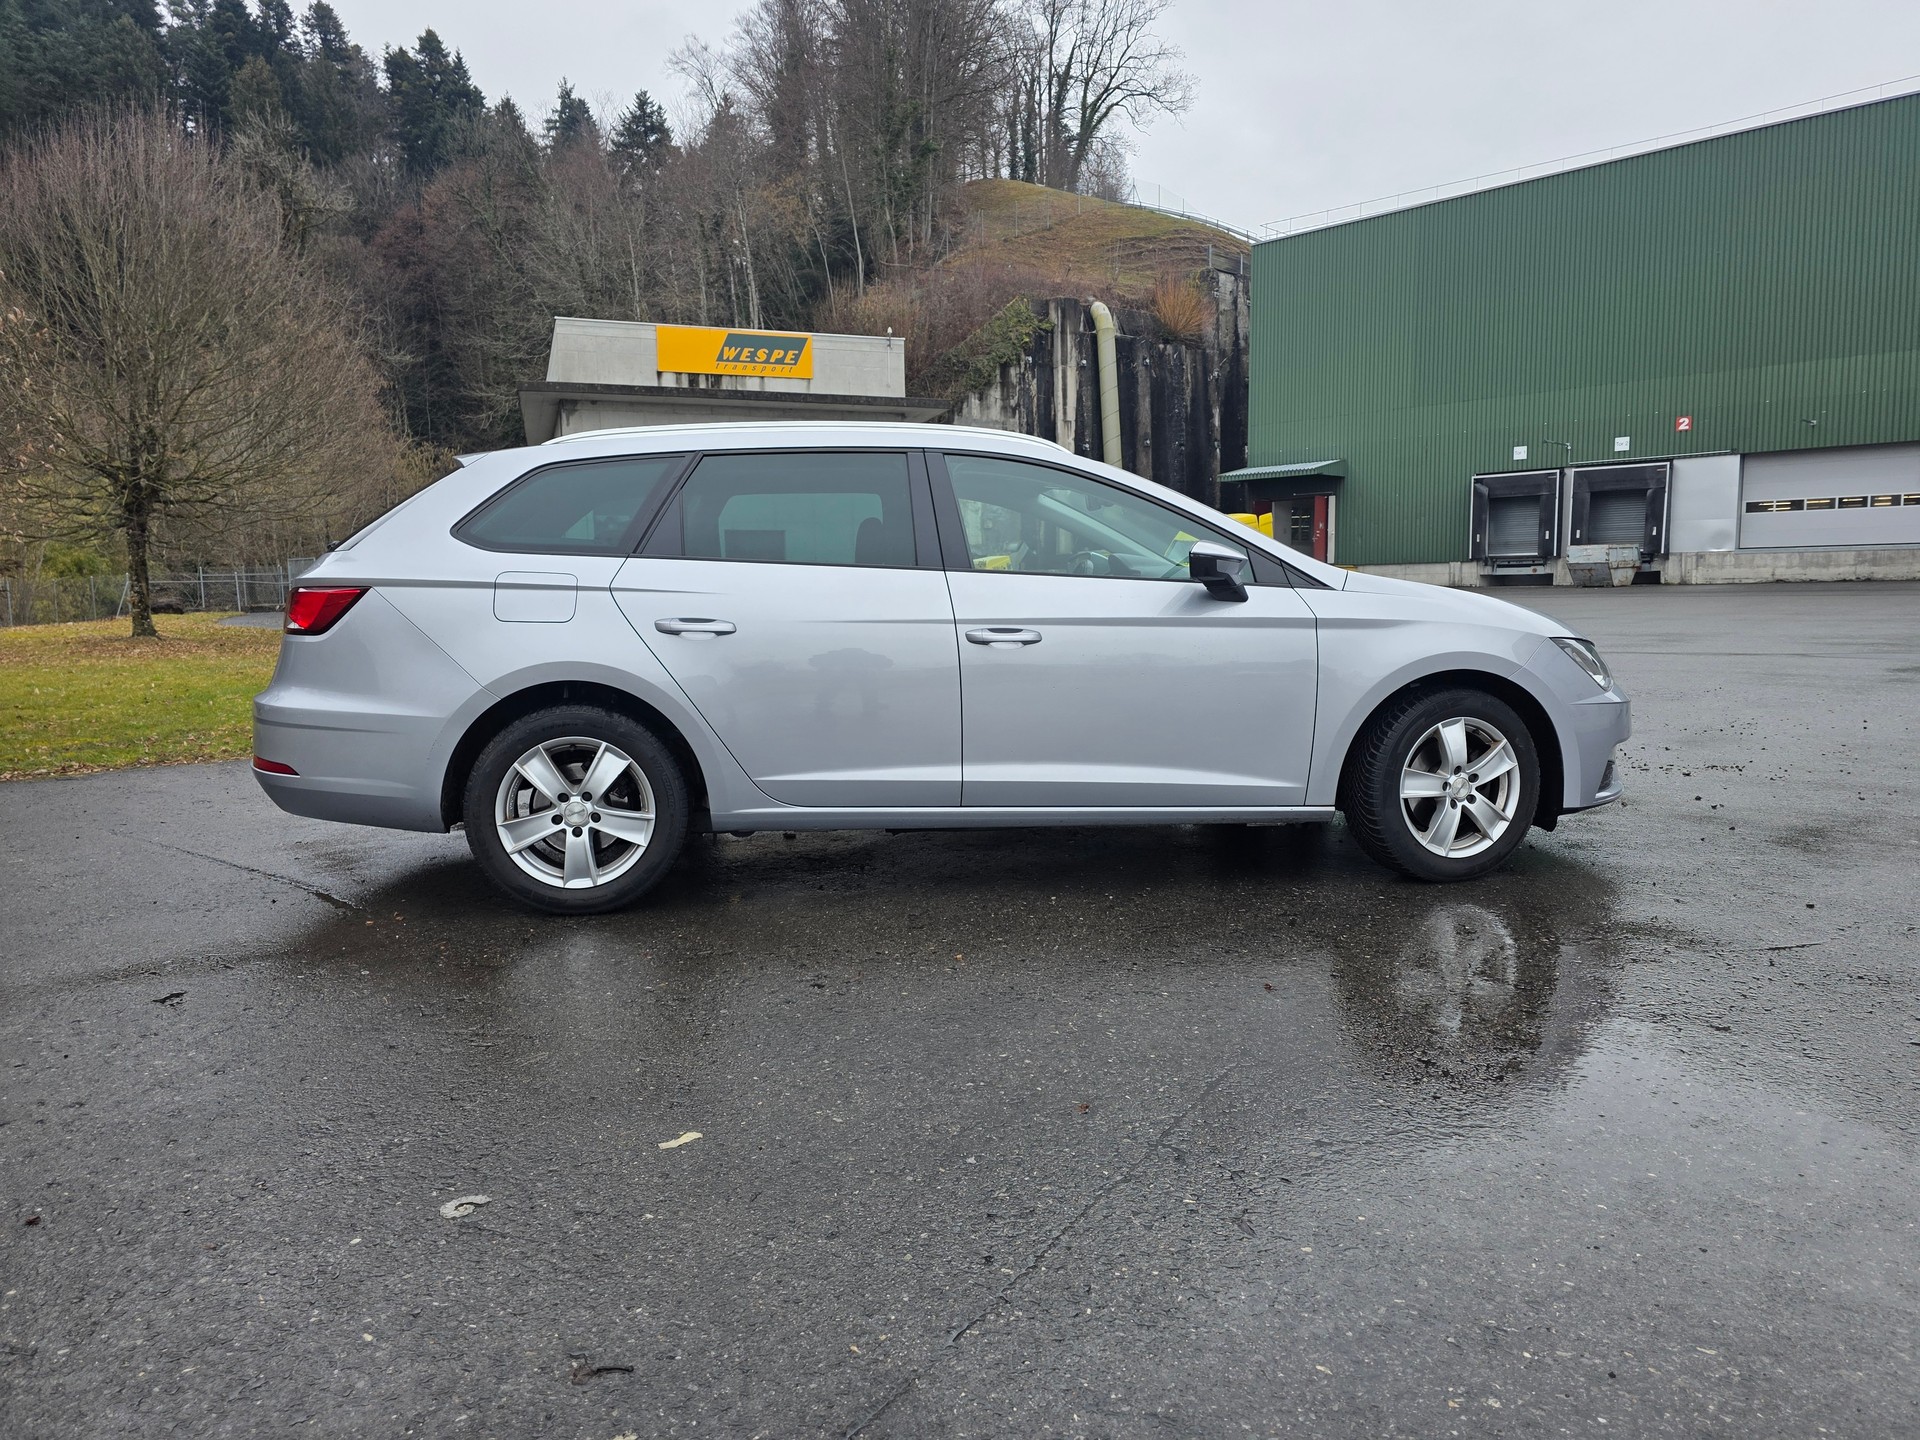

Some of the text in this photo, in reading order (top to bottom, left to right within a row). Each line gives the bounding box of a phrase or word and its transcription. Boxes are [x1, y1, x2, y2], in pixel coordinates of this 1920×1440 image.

[723, 346, 799, 364] WESPE
[716, 363, 794, 373] transport
[1678, 417, 1689, 430] 2
